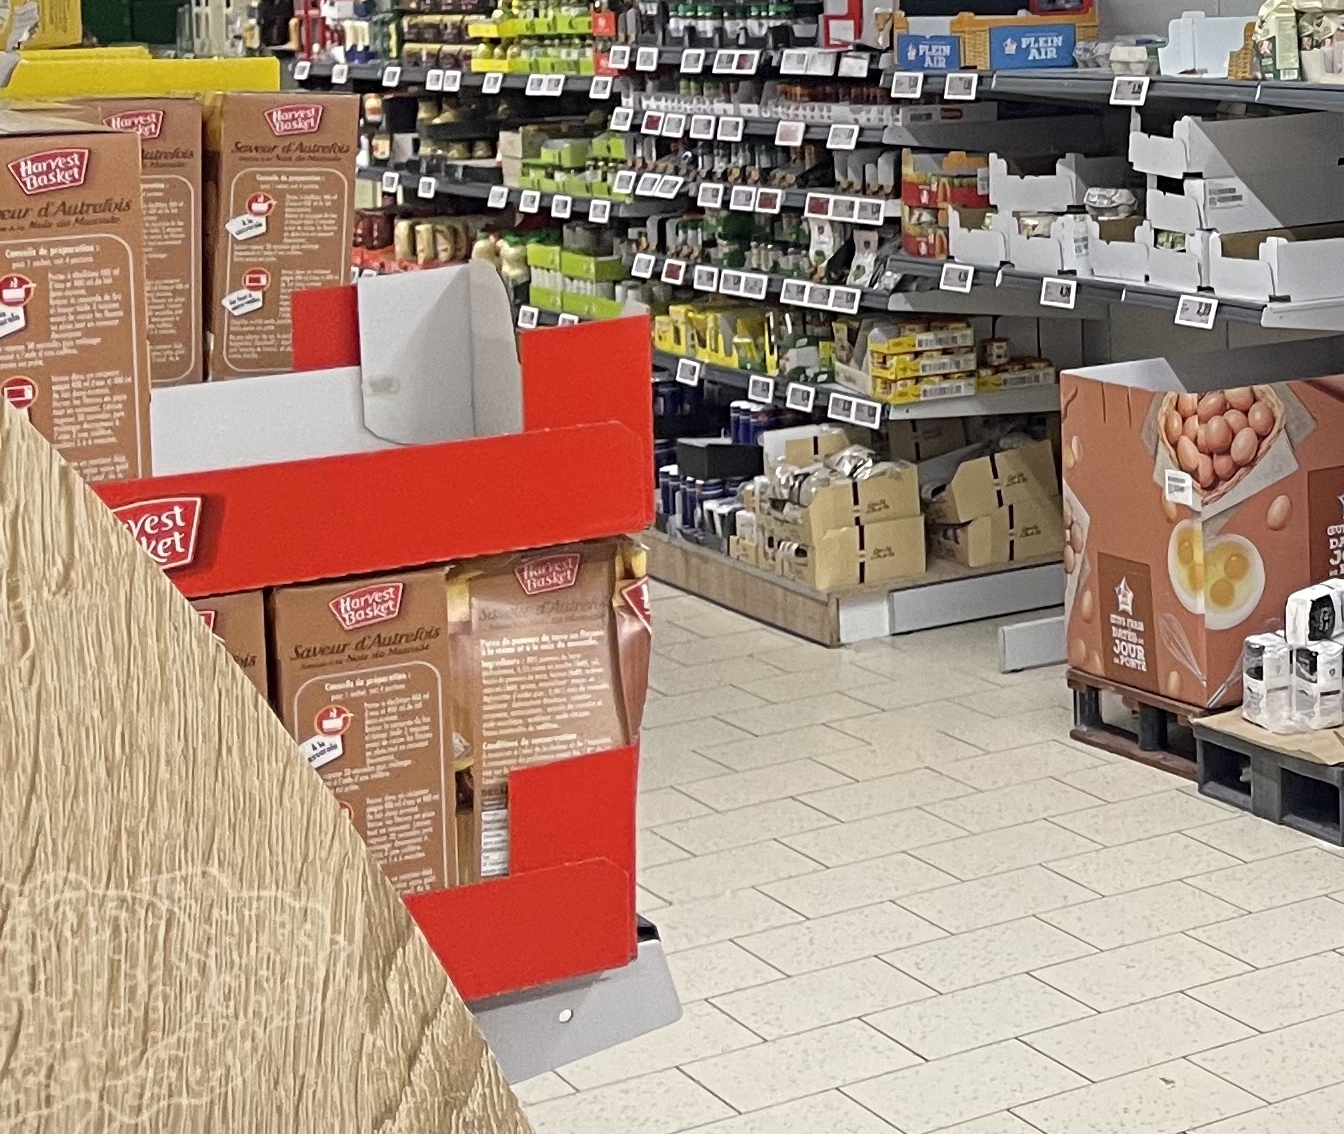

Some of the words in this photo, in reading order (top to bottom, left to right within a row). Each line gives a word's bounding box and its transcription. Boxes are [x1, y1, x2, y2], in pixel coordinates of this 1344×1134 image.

[1021, 36, 1064, 49] PLEIN
[1027, 48, 1058, 60] AIR
[272, 106, 316, 123] Harvest
[275, 117, 315, 133] Basket
[20, 153, 81, 177] Harvest
[22, 167, 80, 190] Basket
[38, 198, 132, 218] d'Autrefois
[124, 505, 186, 540] vest
[140, 530, 185, 563] ket
[526, 570, 573, 592] Basket
[340, 586, 396, 613] Harvest
[342, 601, 397, 627] Basket
[290, 642, 350, 661] Saveur
[353, 626, 440, 652] d'Autrefois
[1113, 641, 1145, 660] JOUR
